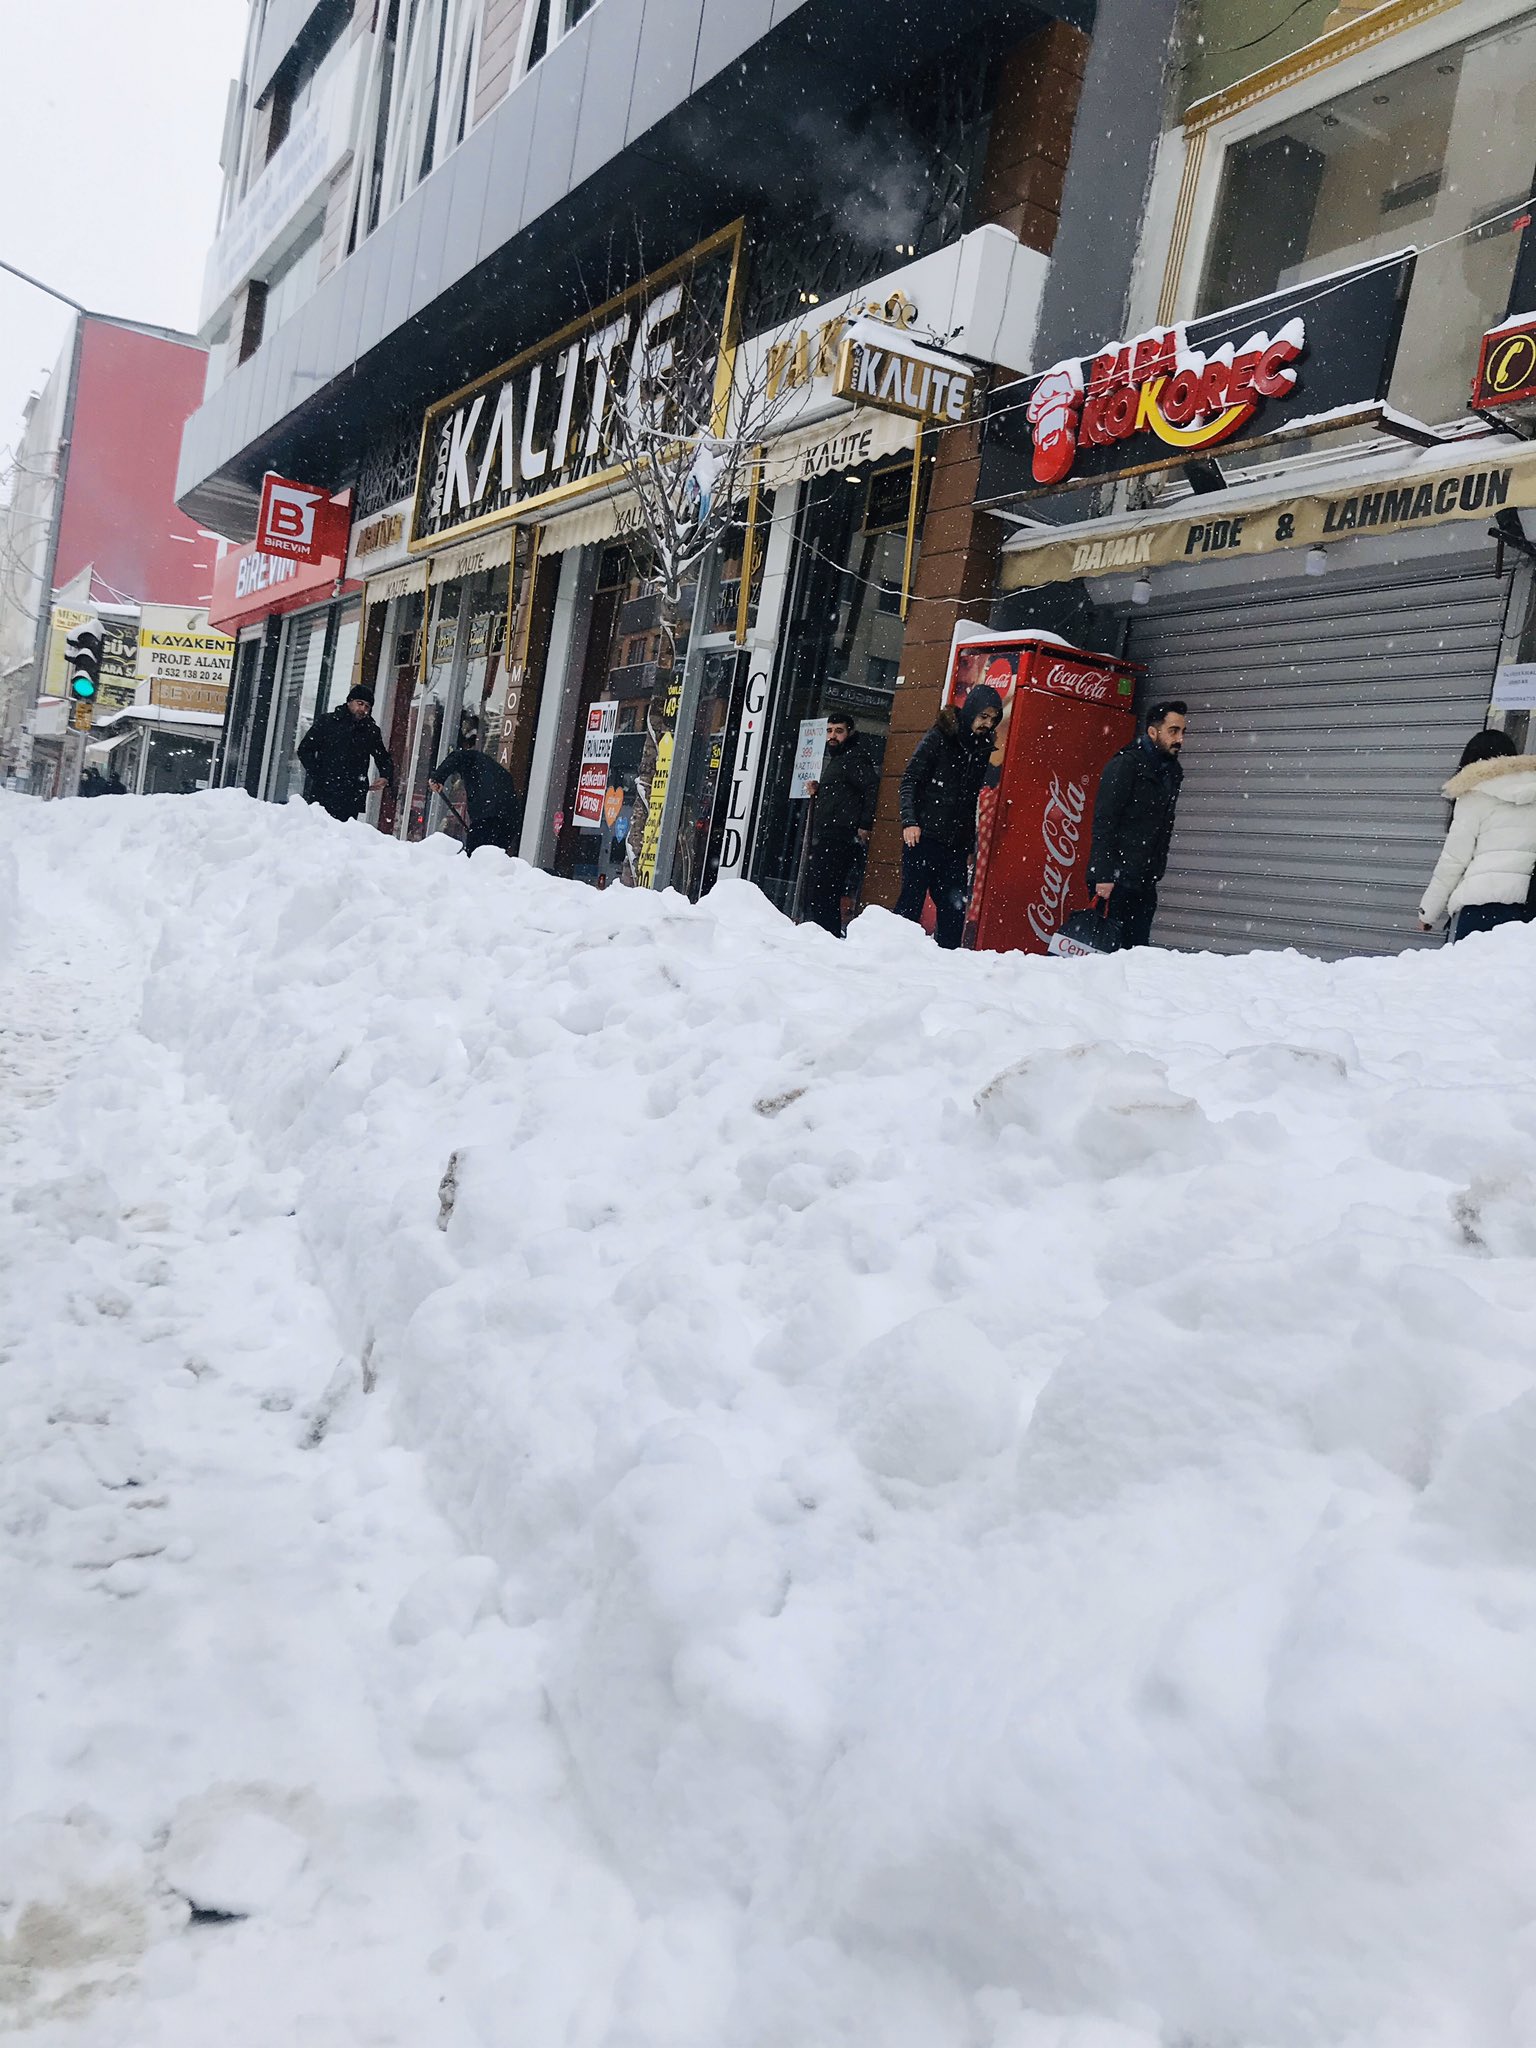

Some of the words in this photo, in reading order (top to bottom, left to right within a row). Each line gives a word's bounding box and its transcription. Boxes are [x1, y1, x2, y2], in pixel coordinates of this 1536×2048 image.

[1088, 330, 1177, 395] BABA
[428, 413, 454, 519] MODA
[271, 499, 304, 537] B
[1071, 532, 1155, 573] DAMAK
[1275, 513, 1295, 542] &
[1322, 468, 1513, 533] LAHMACUN
[152, 635, 236, 651] KAYAKENT
[152, 652, 191, 666] PROJE
[194, 657, 231, 669] ALANI
[157, 667, 163, 675] 0
[165, 668, 180, 677] 532
[183, 670, 197, 678] 138
[200, 671, 210, 680] 20
[212, 672, 222, 681] 24
[1046, 664, 1112, 699] Coca-Cola
[581, 766, 606, 787] etiketin
[1027, 769, 1086, 944] Coca-Cola
